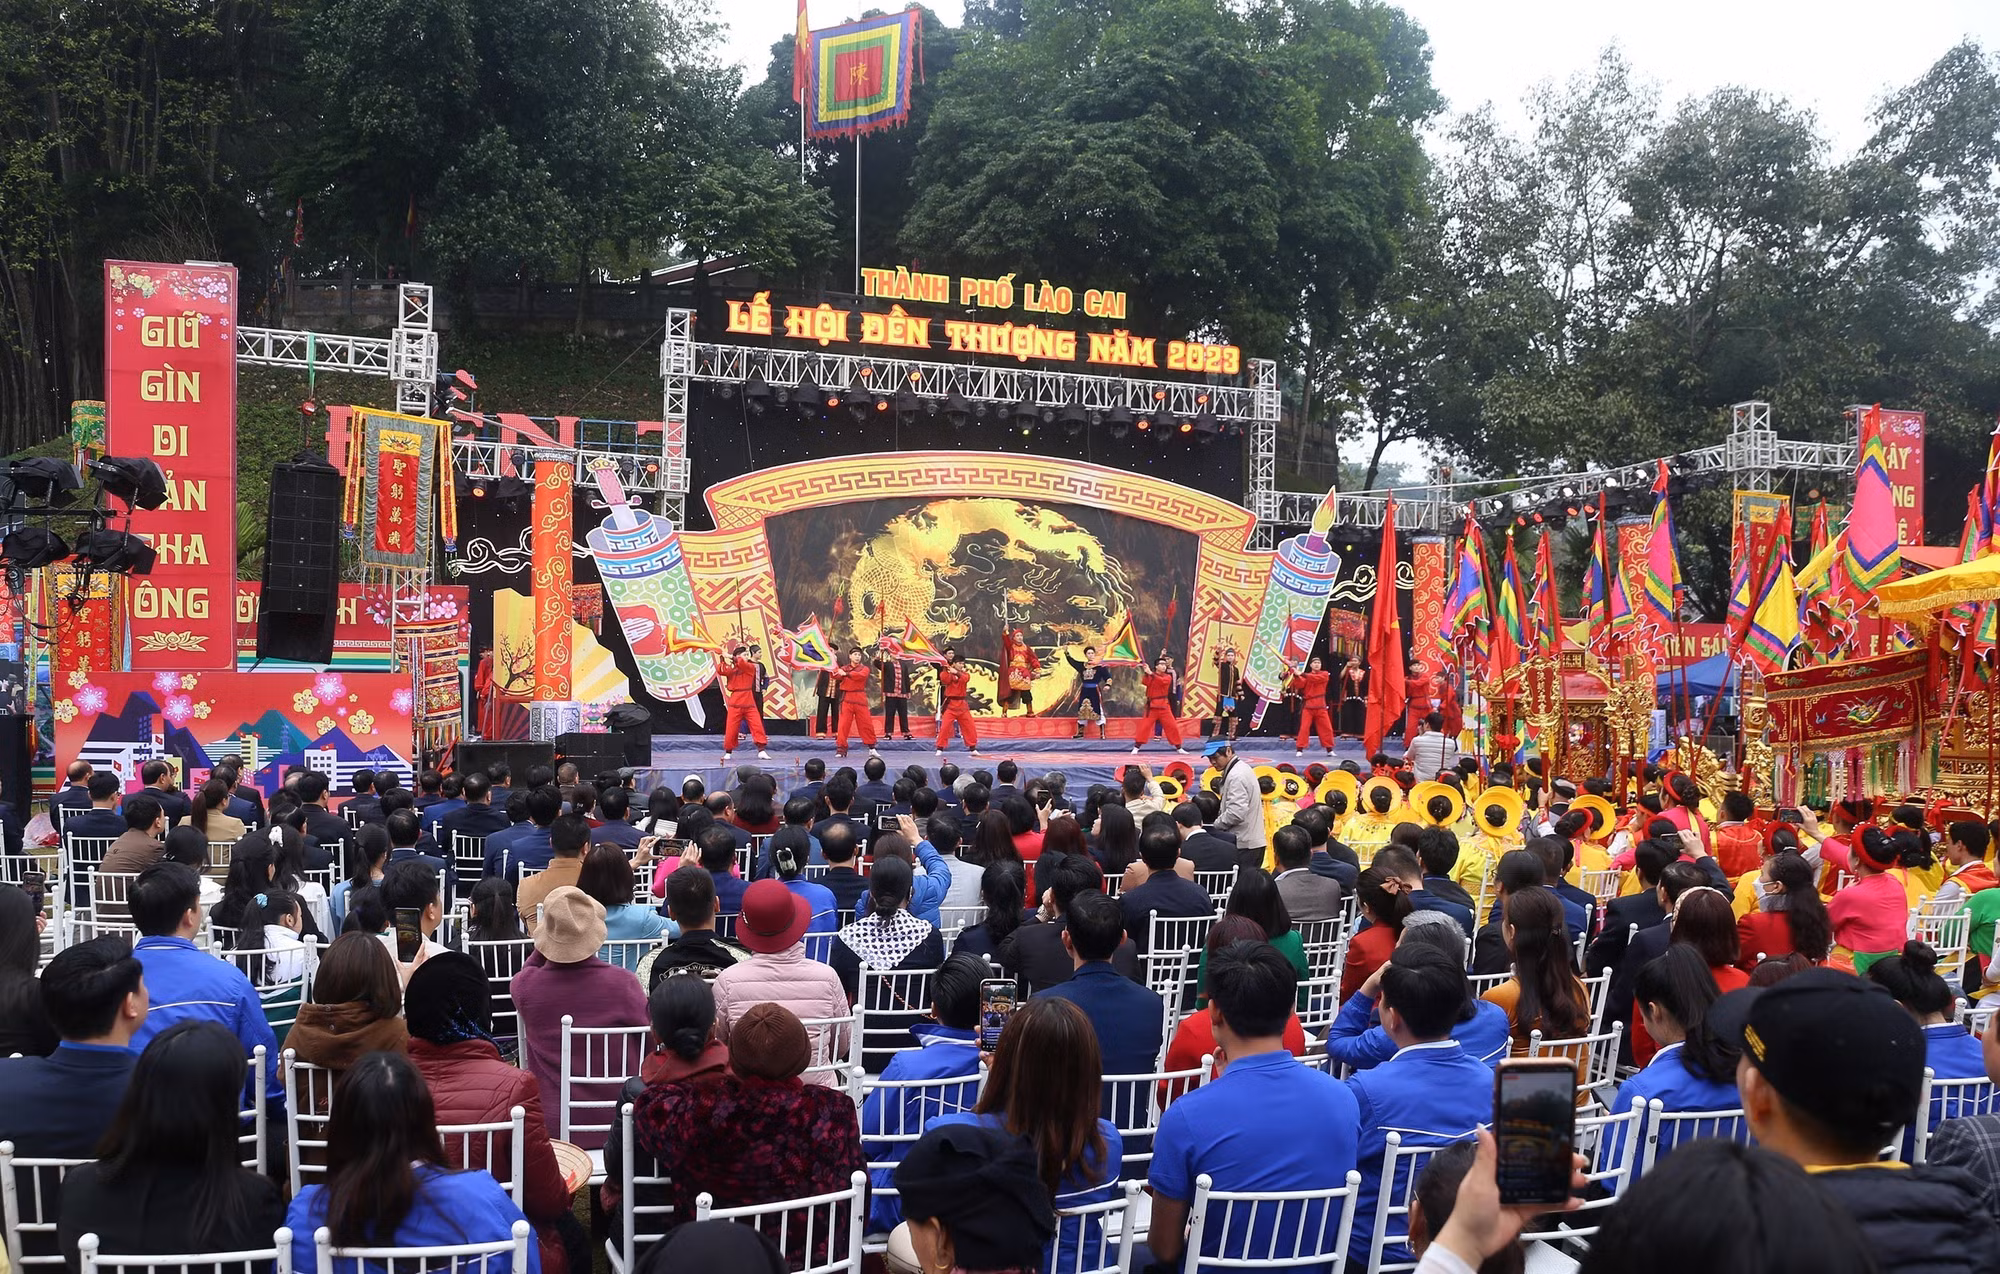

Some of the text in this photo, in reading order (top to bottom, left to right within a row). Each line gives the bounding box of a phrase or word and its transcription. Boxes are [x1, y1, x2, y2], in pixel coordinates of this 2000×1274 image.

[861, 265, 1127, 319] THÀNH PHỐ LÀO CAI
[141, 310, 202, 348] GIỮ
[725, 290, 1240, 375] LỄ HỘI ĐỀN THƯỢNG NĂM 2023
[140, 362, 201, 403] GÌN
[152, 424, 189, 457] DI
[1882, 442, 1909, 470] ÂY
[136, 469, 207, 511] ẢN
[1890, 481, 1916, 508] NG
[133, 580, 209, 619] ÔNG
